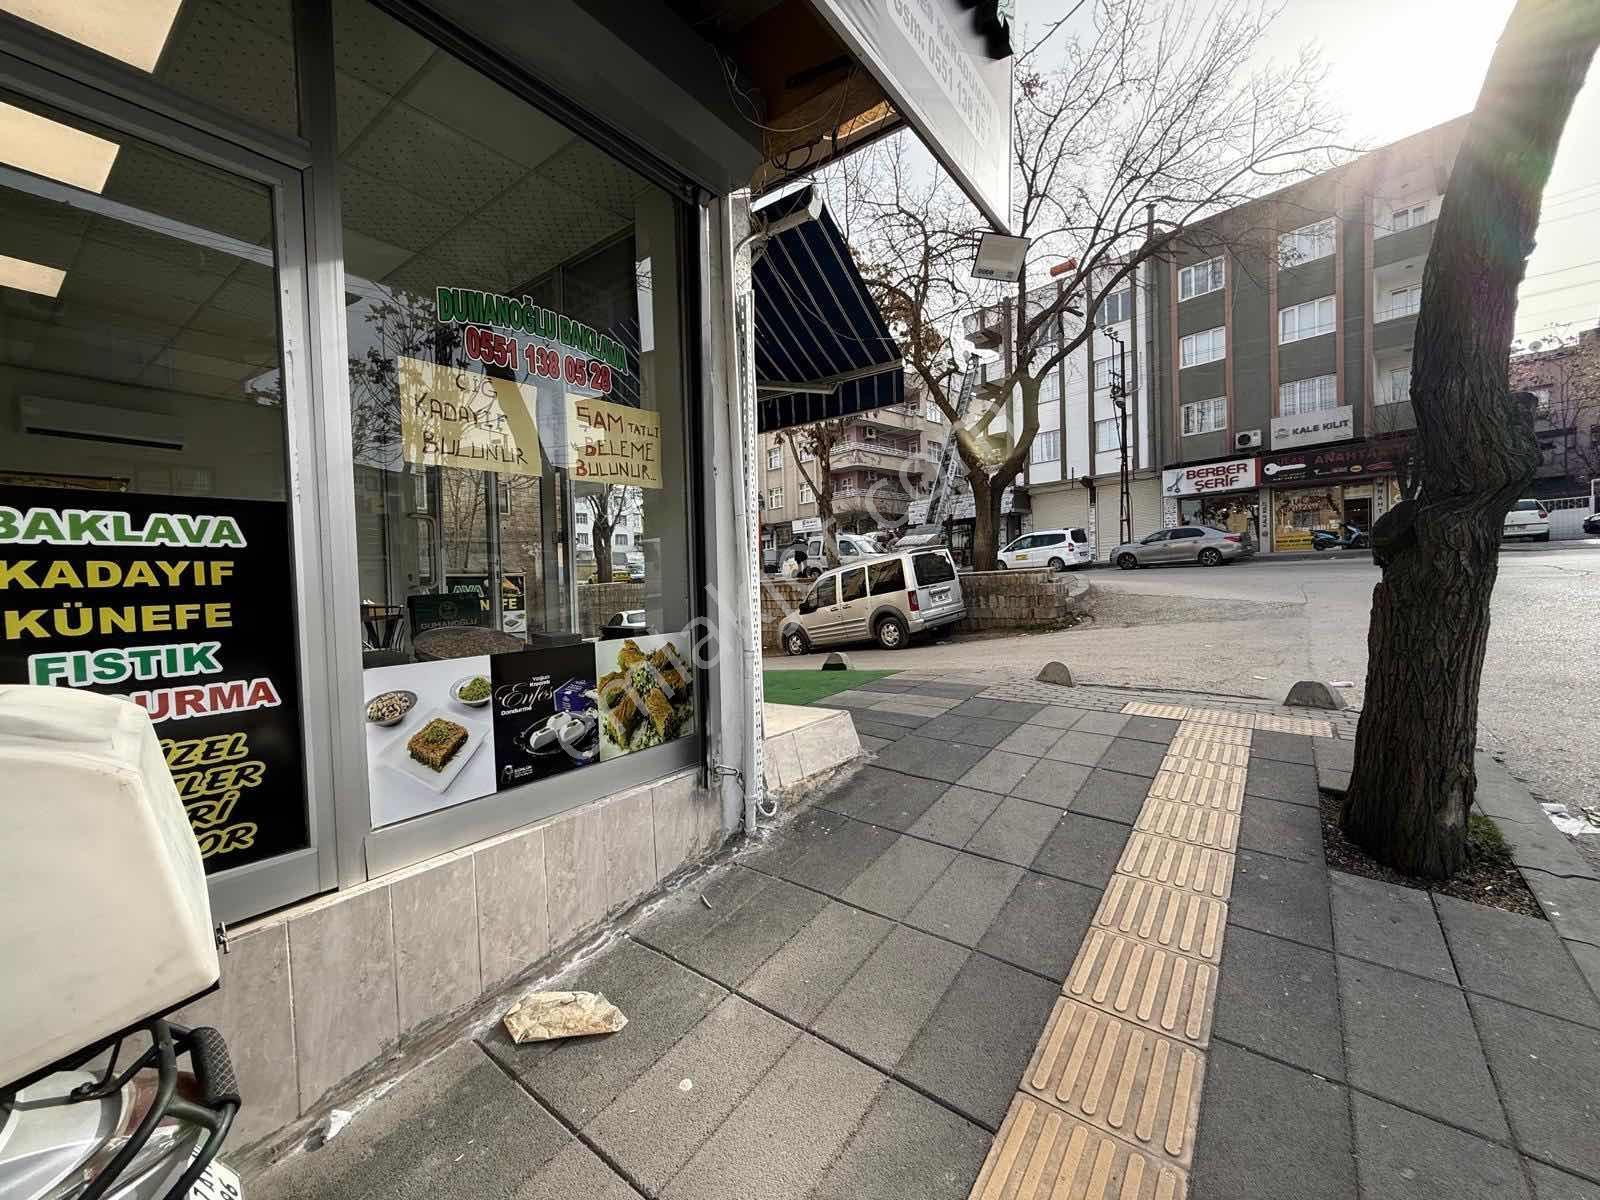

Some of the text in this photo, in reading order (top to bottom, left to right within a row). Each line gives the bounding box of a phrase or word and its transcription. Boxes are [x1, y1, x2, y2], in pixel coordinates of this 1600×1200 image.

[436, 286, 630, 376] DUMANOĞLU BAKLAVA
[464, 325, 613, 394] 0551 138 05 28
[423, 430, 528, 464] BULUNUR
[1292, 424, 1320, 435] KALE
[1186, 463, 1248, 480] BERBER
[0, 560, 235, 589] KADAYIF
[4, 602, 233, 640] KÜNEFE
[28, 641, 223, 687] FISTIK
